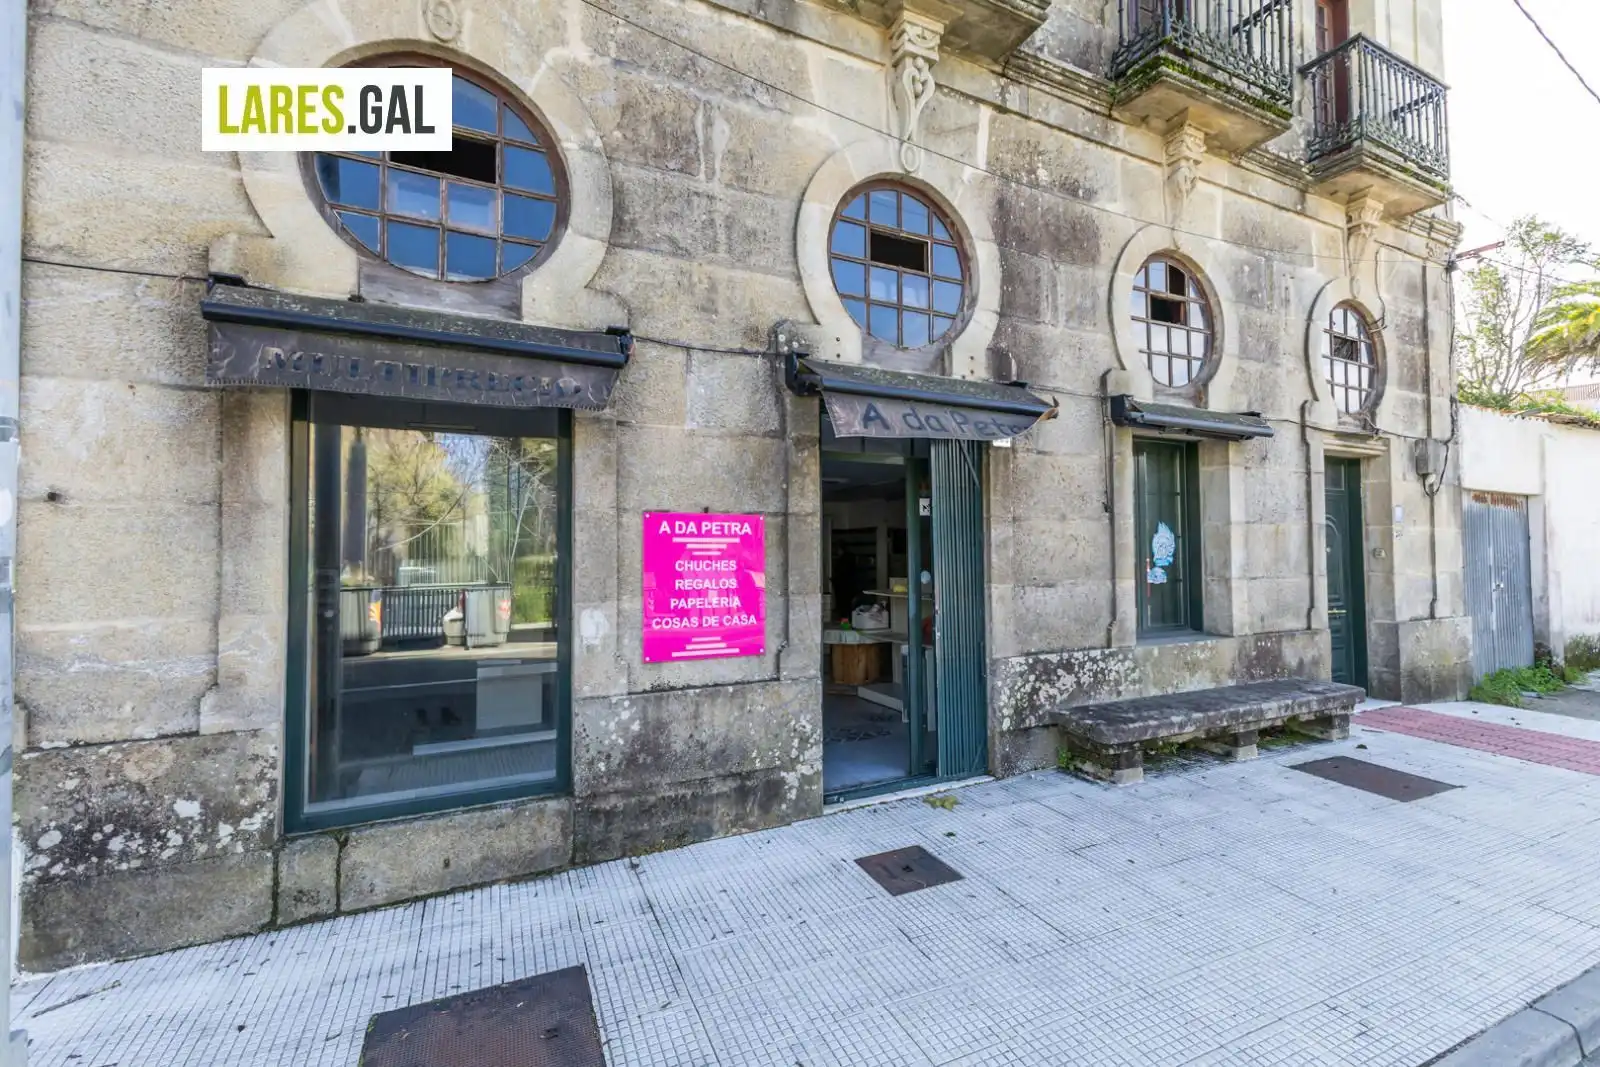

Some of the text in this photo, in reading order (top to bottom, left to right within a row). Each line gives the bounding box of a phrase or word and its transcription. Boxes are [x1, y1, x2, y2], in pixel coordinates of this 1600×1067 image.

[862, 402, 890, 430] A
[902, 407, 949, 432] da
[659, 520, 752, 535] A DA PETRA
[675, 560, 737, 571] CHUCHES
[675, 578, 737, 590] REGALOS
[652, 615, 757, 629] COSAS DE CASA
